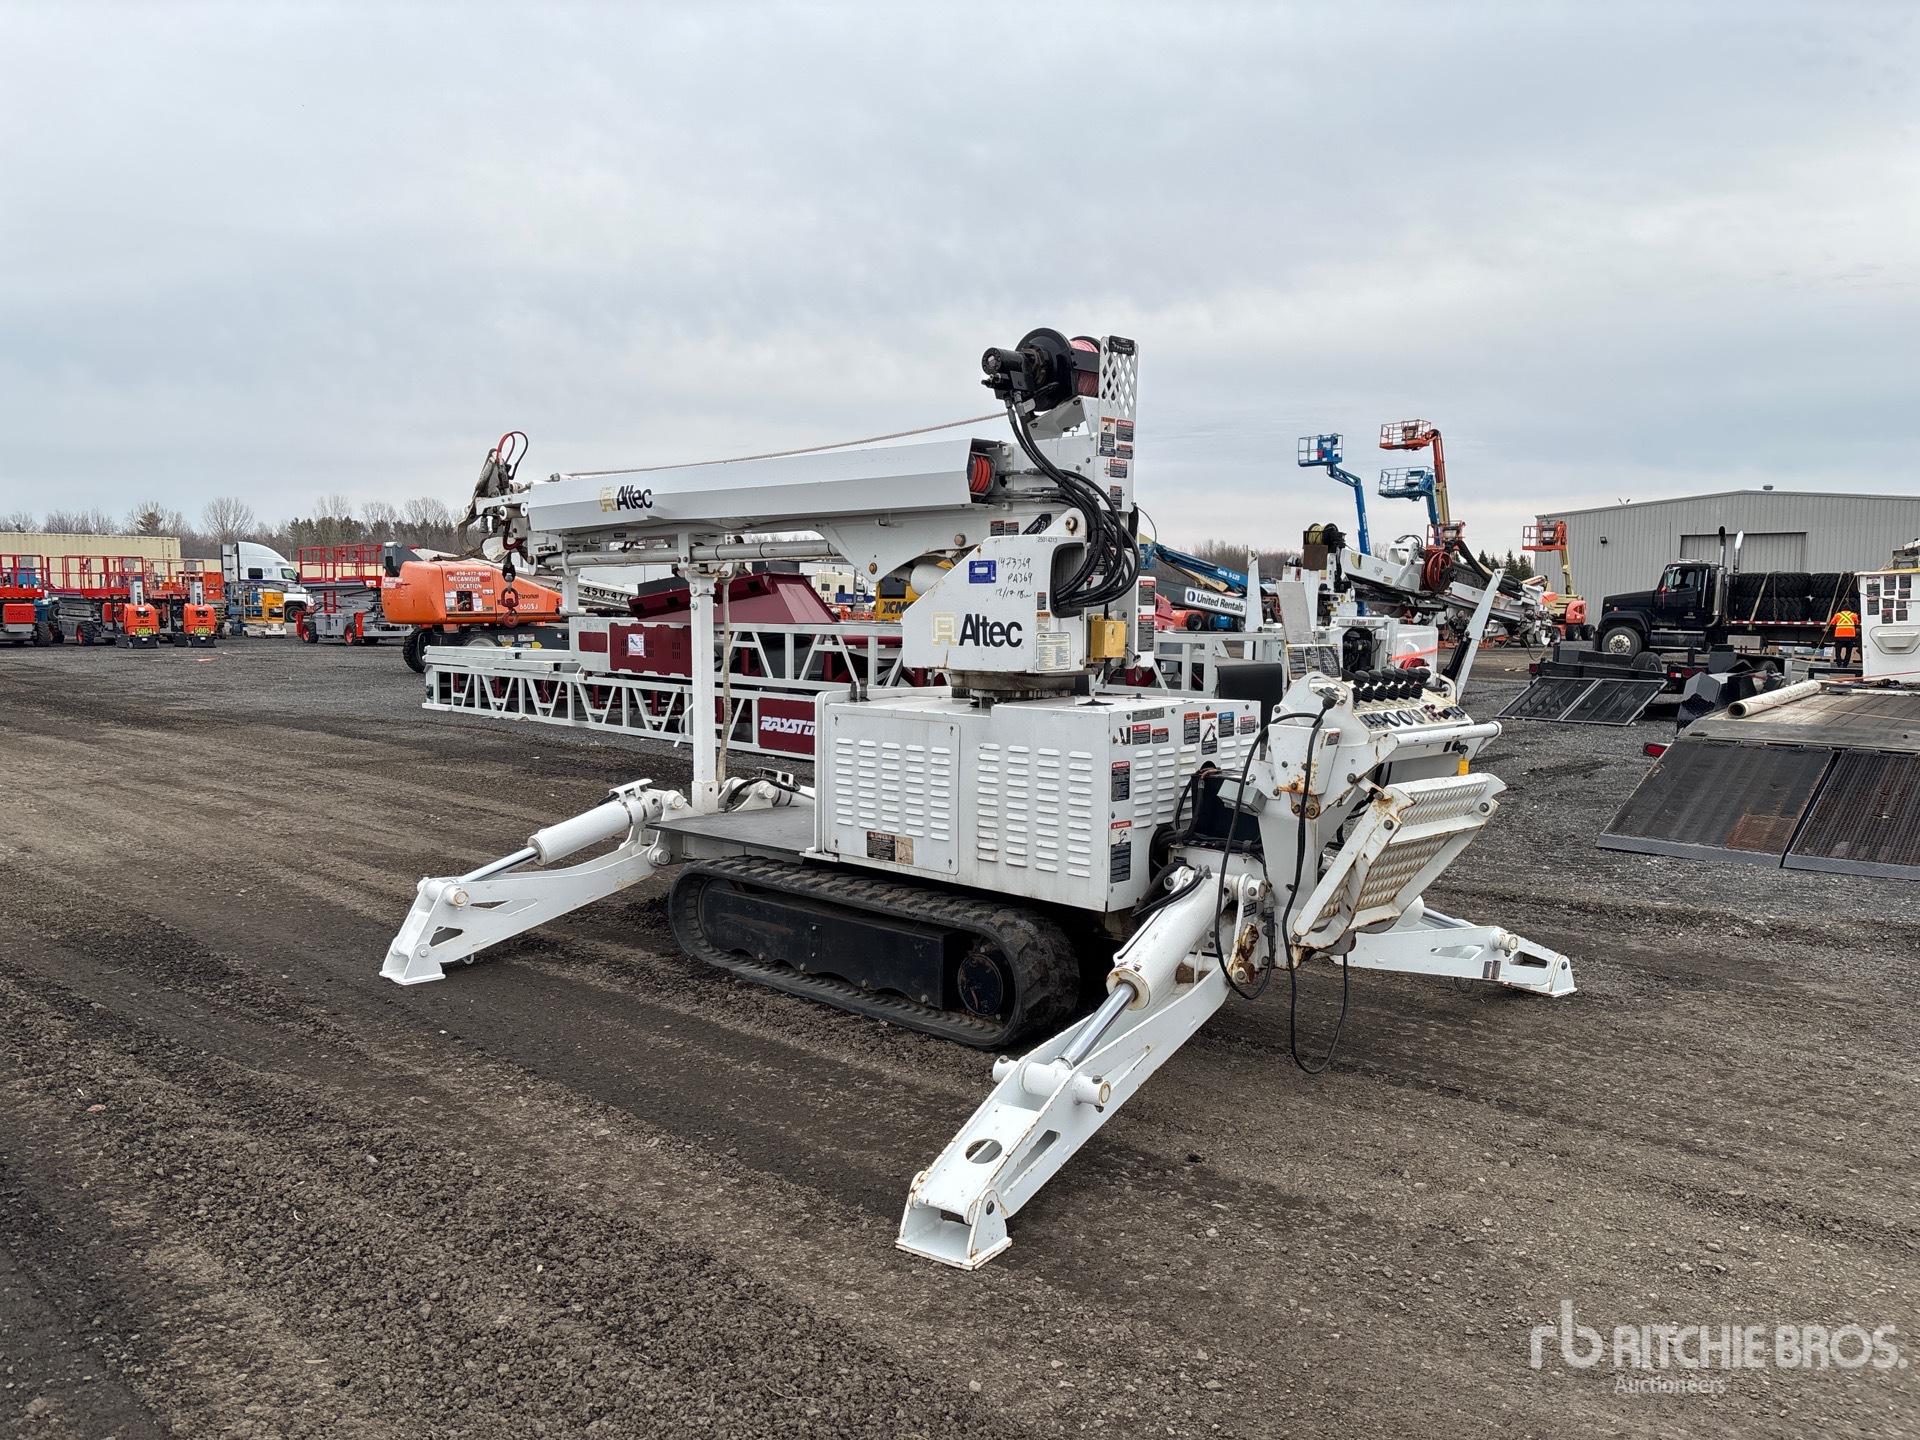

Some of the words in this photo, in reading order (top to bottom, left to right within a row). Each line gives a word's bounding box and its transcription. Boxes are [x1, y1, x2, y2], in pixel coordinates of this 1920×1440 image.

[617, 485, 653, 511] Altec
[1196, 593, 1220, 607] United
[1220, 598, 1244, 612] Rentals
[958, 613, 1023, 648] Altec
